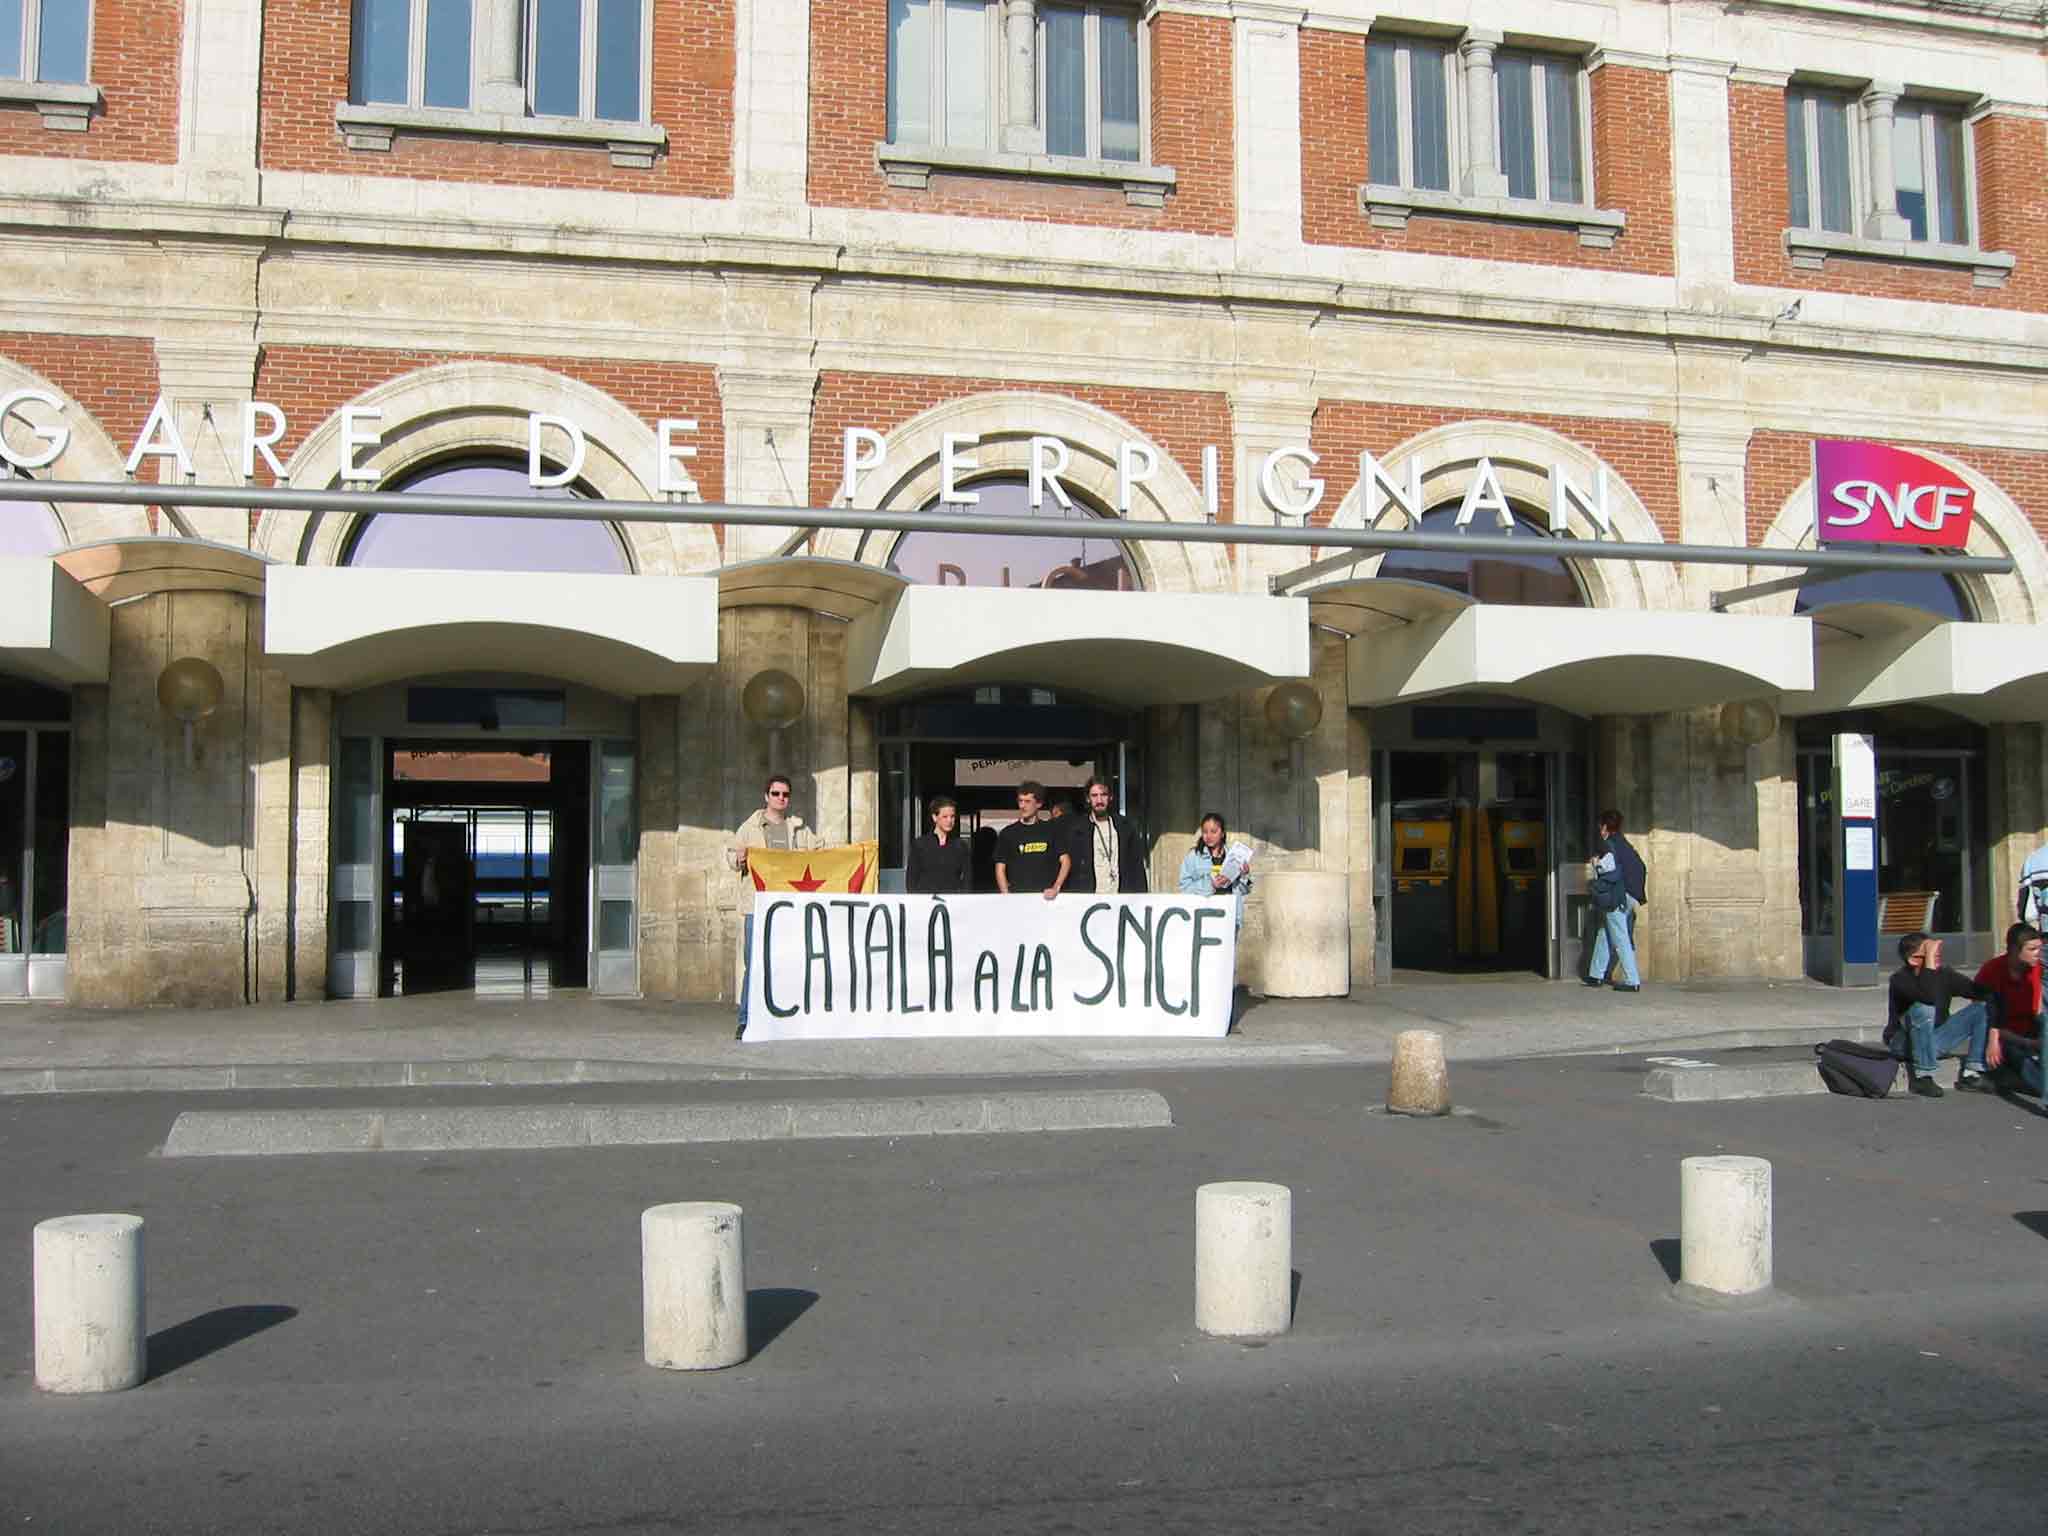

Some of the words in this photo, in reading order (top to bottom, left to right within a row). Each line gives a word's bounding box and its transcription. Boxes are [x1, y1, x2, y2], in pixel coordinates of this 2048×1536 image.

[0, 388, 383, 482] GARE
[527, 412, 701, 494] DE
[843, 425, 1610, 535] PERPIGNAN
[1827, 479, 1971, 531] SNCF
[763, 894, 954, 1018] CATALÀ
[973, 949, 1000, 1013] A
[1012, 943, 1054, 1013] LA
[1073, 902, 1226, 1017] SNCF
